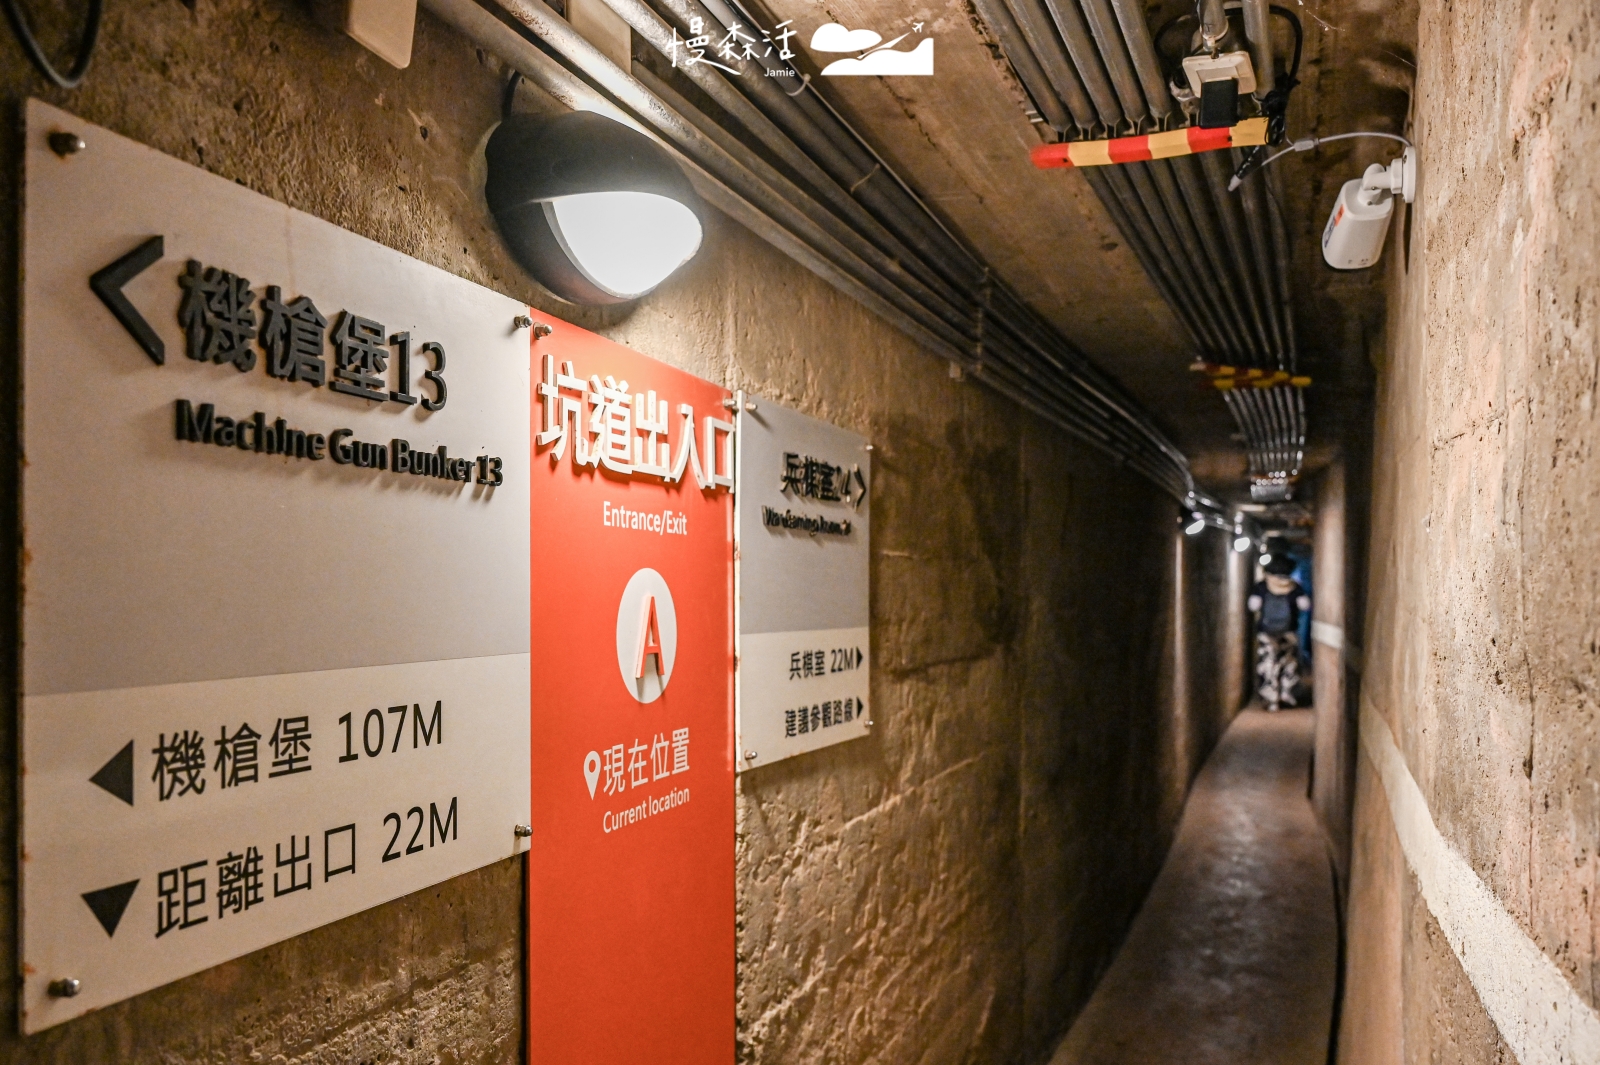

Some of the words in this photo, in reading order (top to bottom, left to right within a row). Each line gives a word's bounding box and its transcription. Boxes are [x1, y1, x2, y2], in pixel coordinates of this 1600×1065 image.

[177, 258, 447, 411] 機槍堡13
[174, 398, 326, 461] Machine
[329, 428, 389, 471] Gun
[391, 438, 476, 483] Bunker
[476, 454, 504, 487] 13
[536, 354, 735, 493] 坑道出入口
[602, 500, 688, 537] Entrance/Exit
[635, 594, 666, 679] A
[789, 649, 826, 681] 兵棋室
[830, 647, 854, 673] 22M
[151, 715, 313, 803] 機槍堡
[338, 699, 443, 763] 107M
[603, 727, 691, 797] 現在位置
[602, 801, 648, 834] Current
[648, 786, 691, 816] location
[155, 822, 357, 939] 距離出口
[381, 796, 459, 864] 22M
